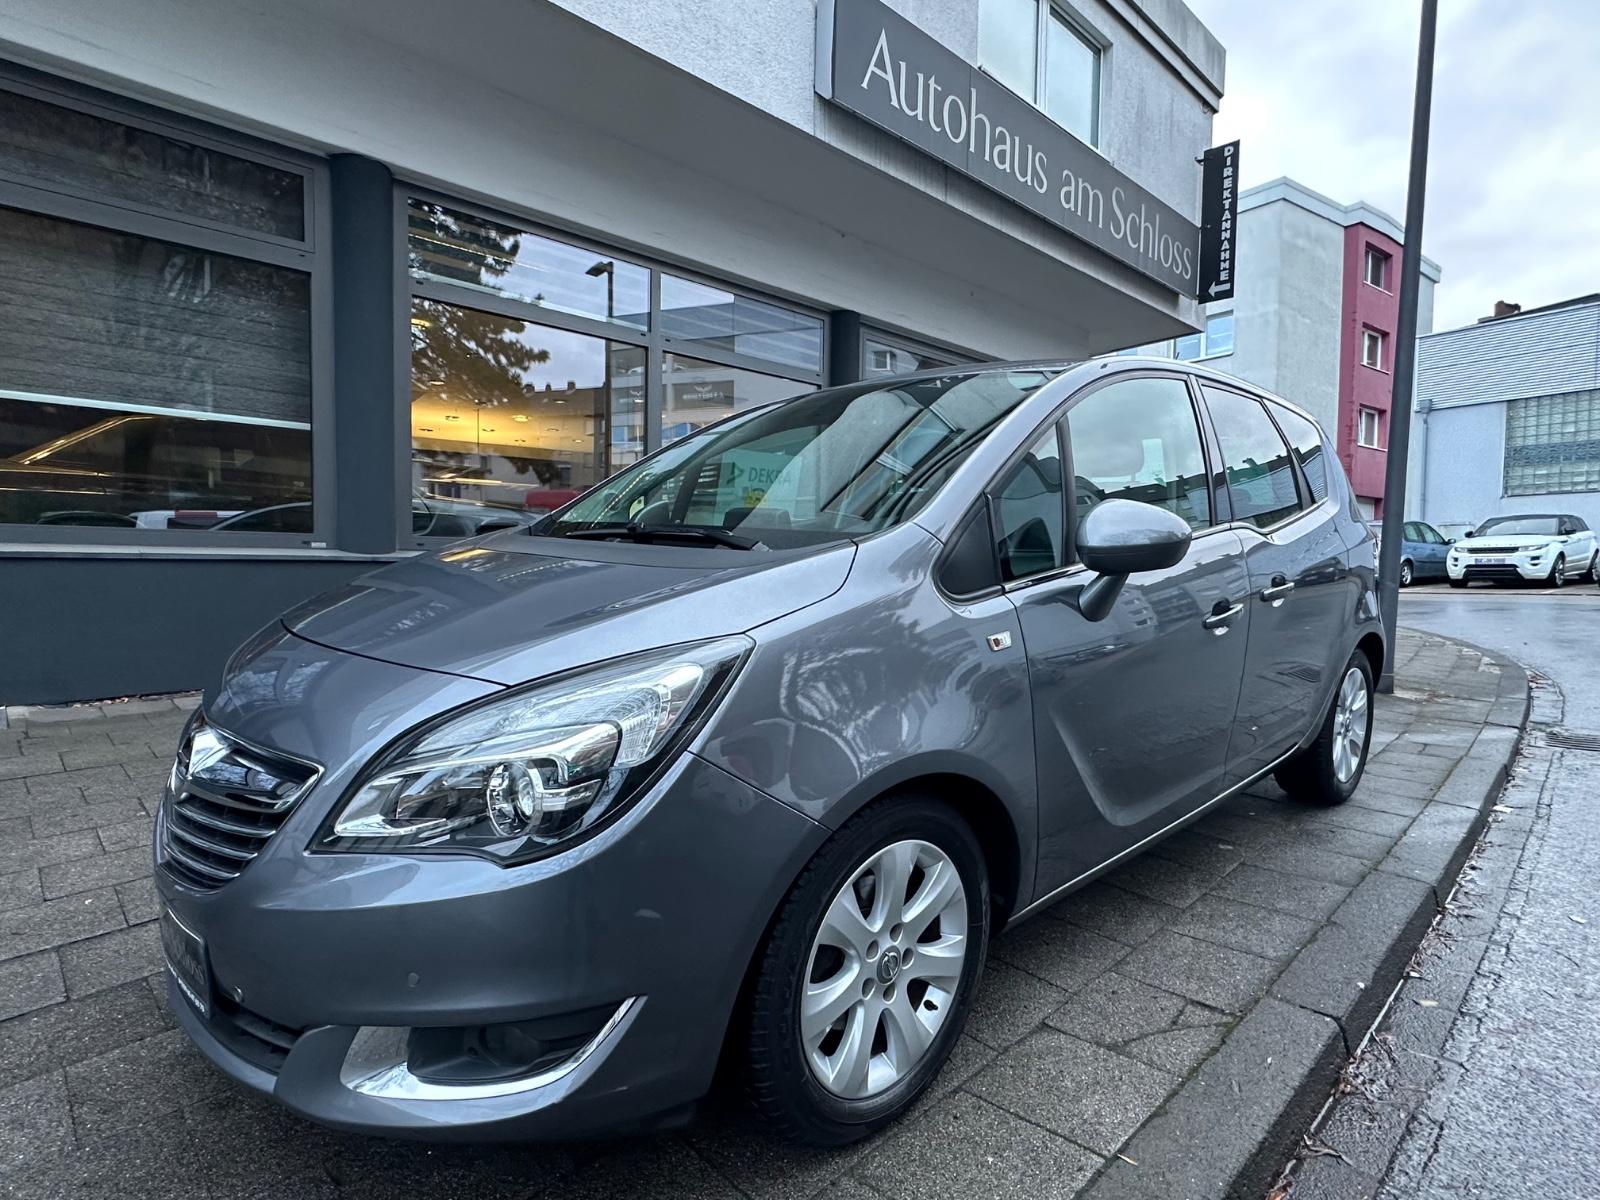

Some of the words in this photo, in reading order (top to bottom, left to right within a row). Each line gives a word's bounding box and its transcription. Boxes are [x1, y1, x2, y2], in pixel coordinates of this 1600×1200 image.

[860, 27, 1048, 194] Autohaus
[1060, 169, 1104, 229] am
[1110, 186, 1192, 280] Schloss
[1220, 146, 1234, 281] DIREKTANNAHME
